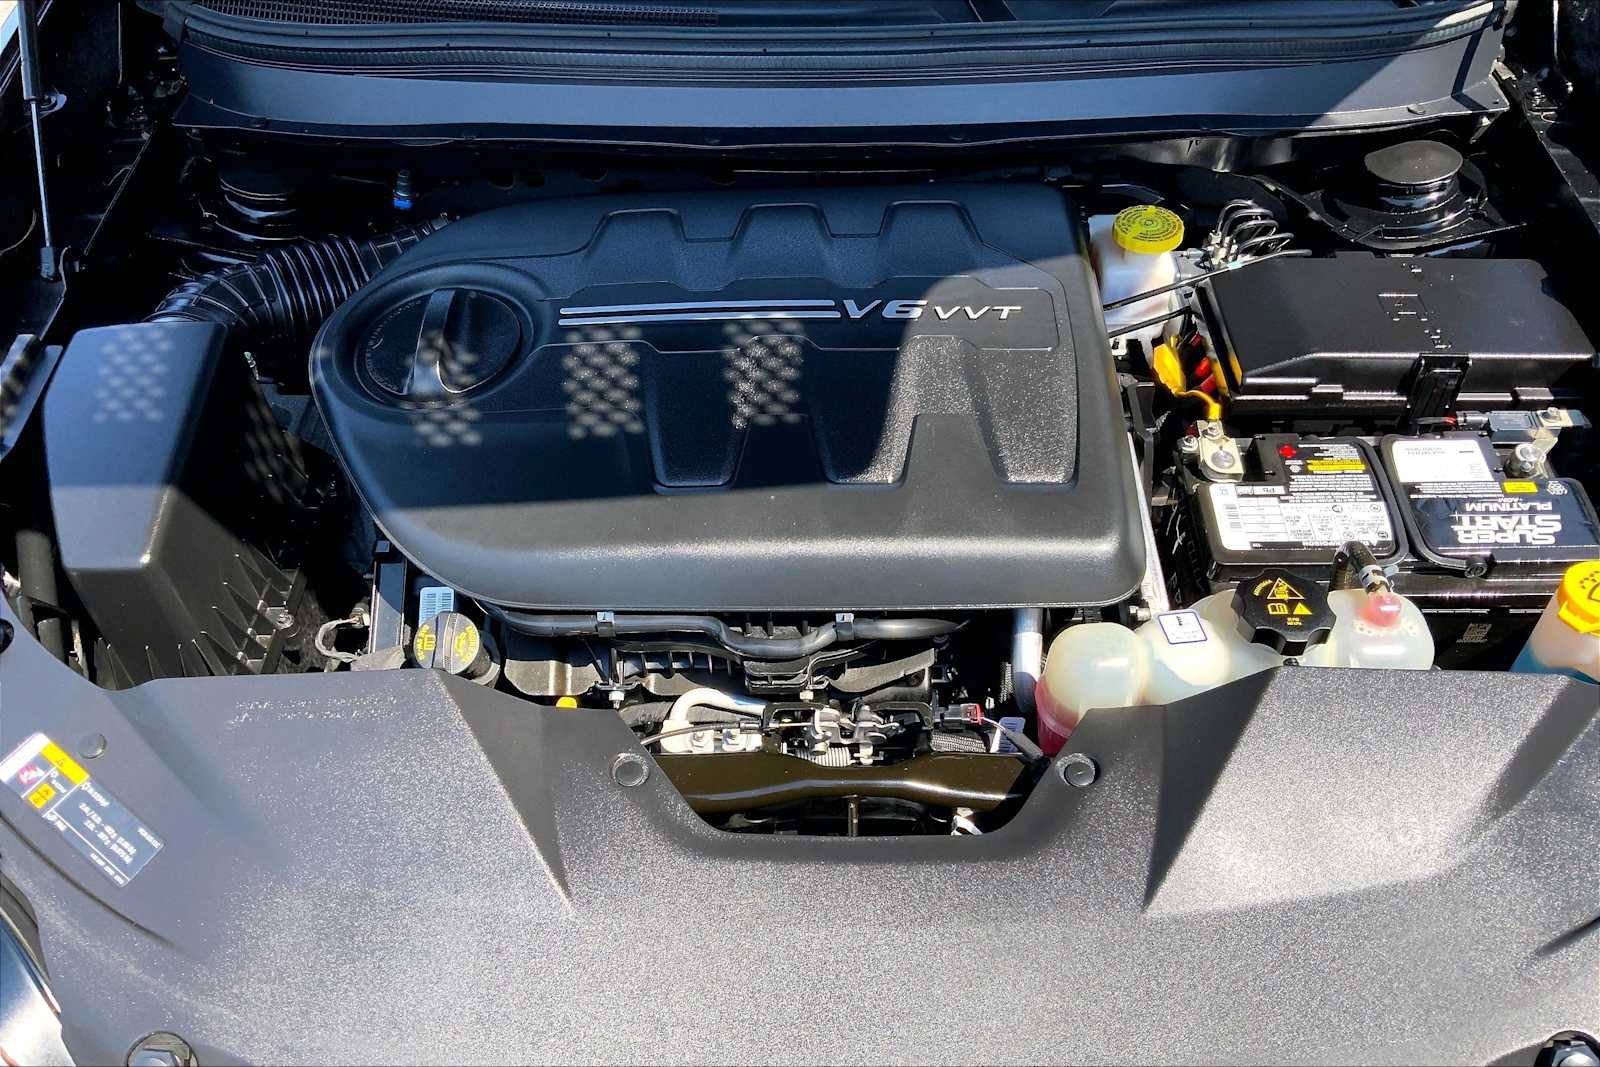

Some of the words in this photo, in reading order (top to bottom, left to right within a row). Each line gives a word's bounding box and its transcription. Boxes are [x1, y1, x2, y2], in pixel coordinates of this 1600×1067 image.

[842, 299, 928, 320] V6
[934, 305, 1022, 321] VVT
[1465, 501, 1553, 512] PLATINUM
[1451, 513, 1562, 533] START
[1457, 529, 1556, 545] SUPER
